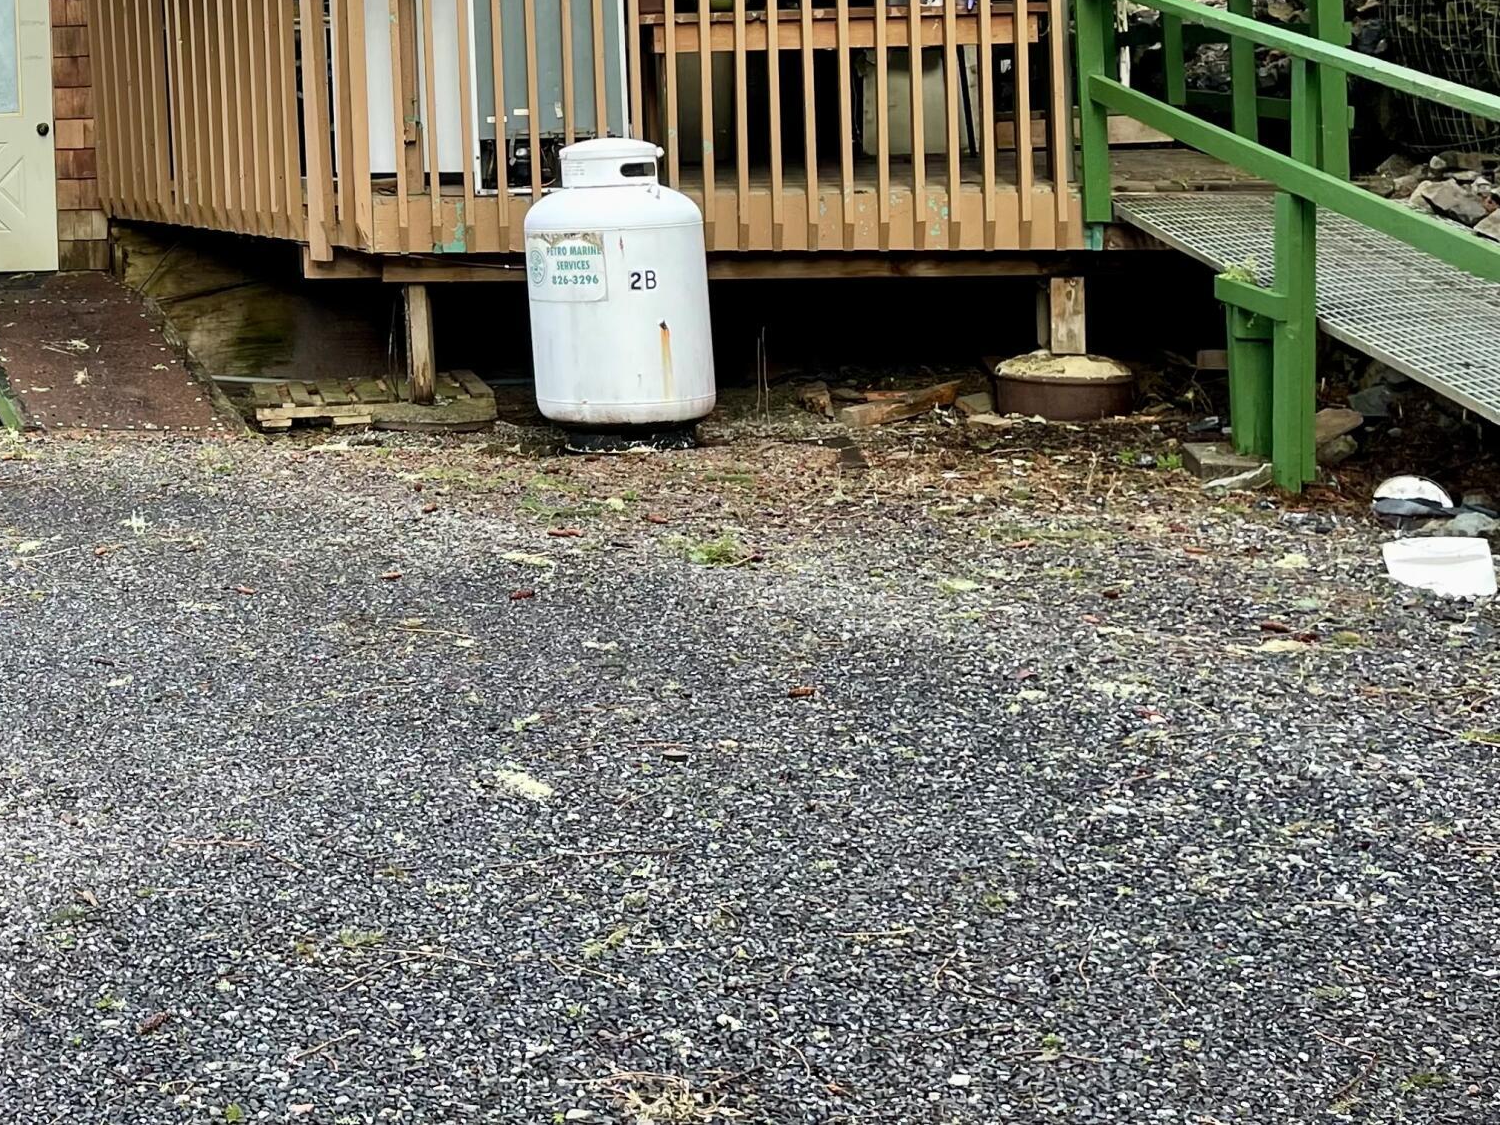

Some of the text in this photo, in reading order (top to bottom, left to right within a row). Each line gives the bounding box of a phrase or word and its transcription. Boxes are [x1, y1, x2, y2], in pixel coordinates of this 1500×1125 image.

[547, 246, 567, 256] PETRO
[557, 260, 590, 270] SERVICES
[552, 275, 599, 285] 826-3296
